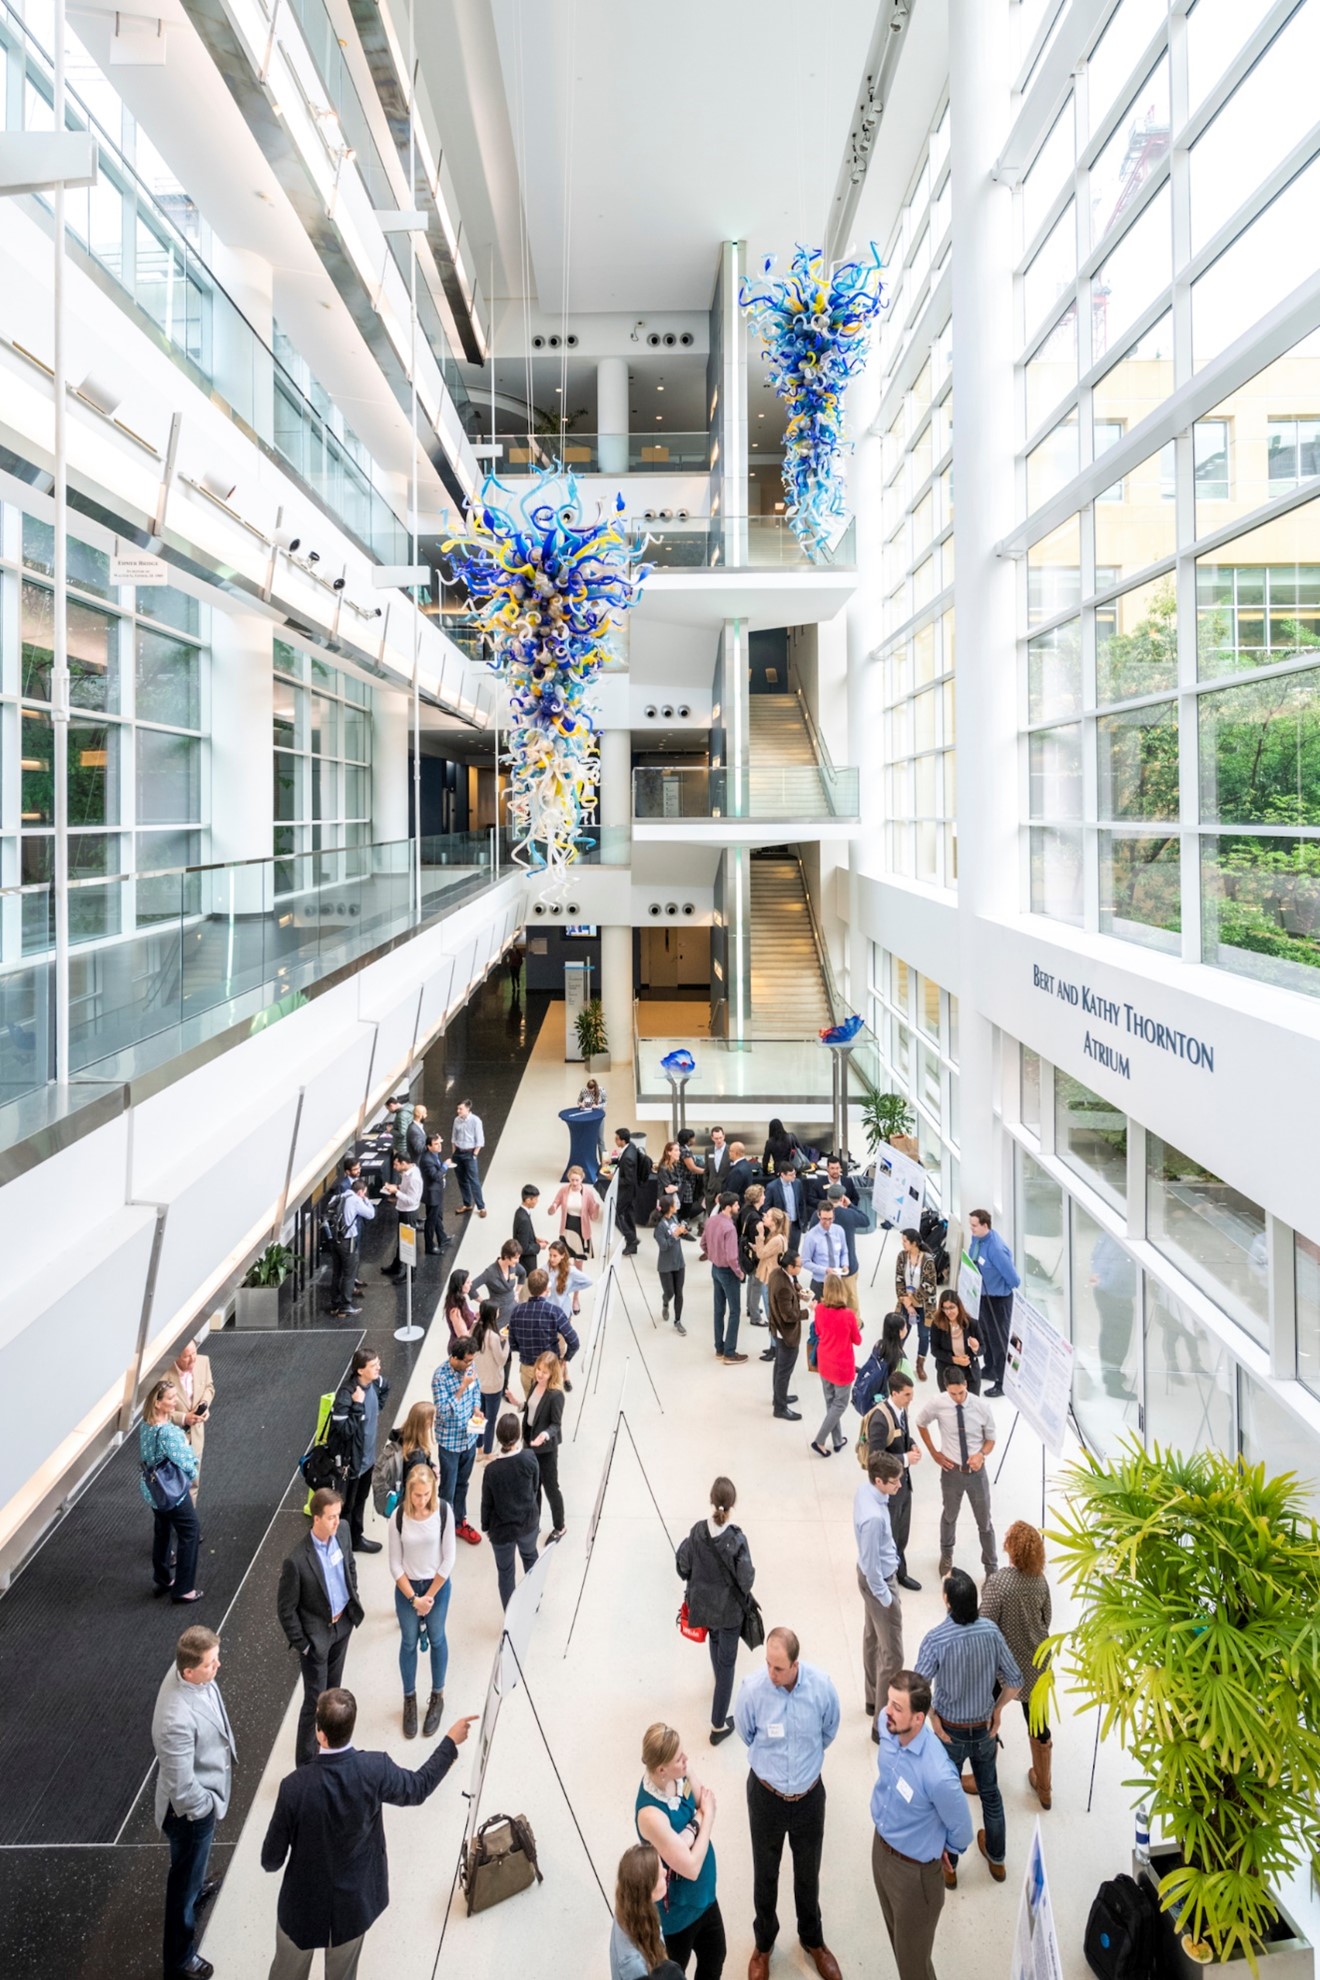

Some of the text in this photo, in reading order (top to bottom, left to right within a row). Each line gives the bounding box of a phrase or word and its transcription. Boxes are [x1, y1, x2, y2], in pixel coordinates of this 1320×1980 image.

[1033, 963, 1214, 1072] BERT AND KATHY THORNTON
[1083, 1030, 1131, 1080] ATRIUM
